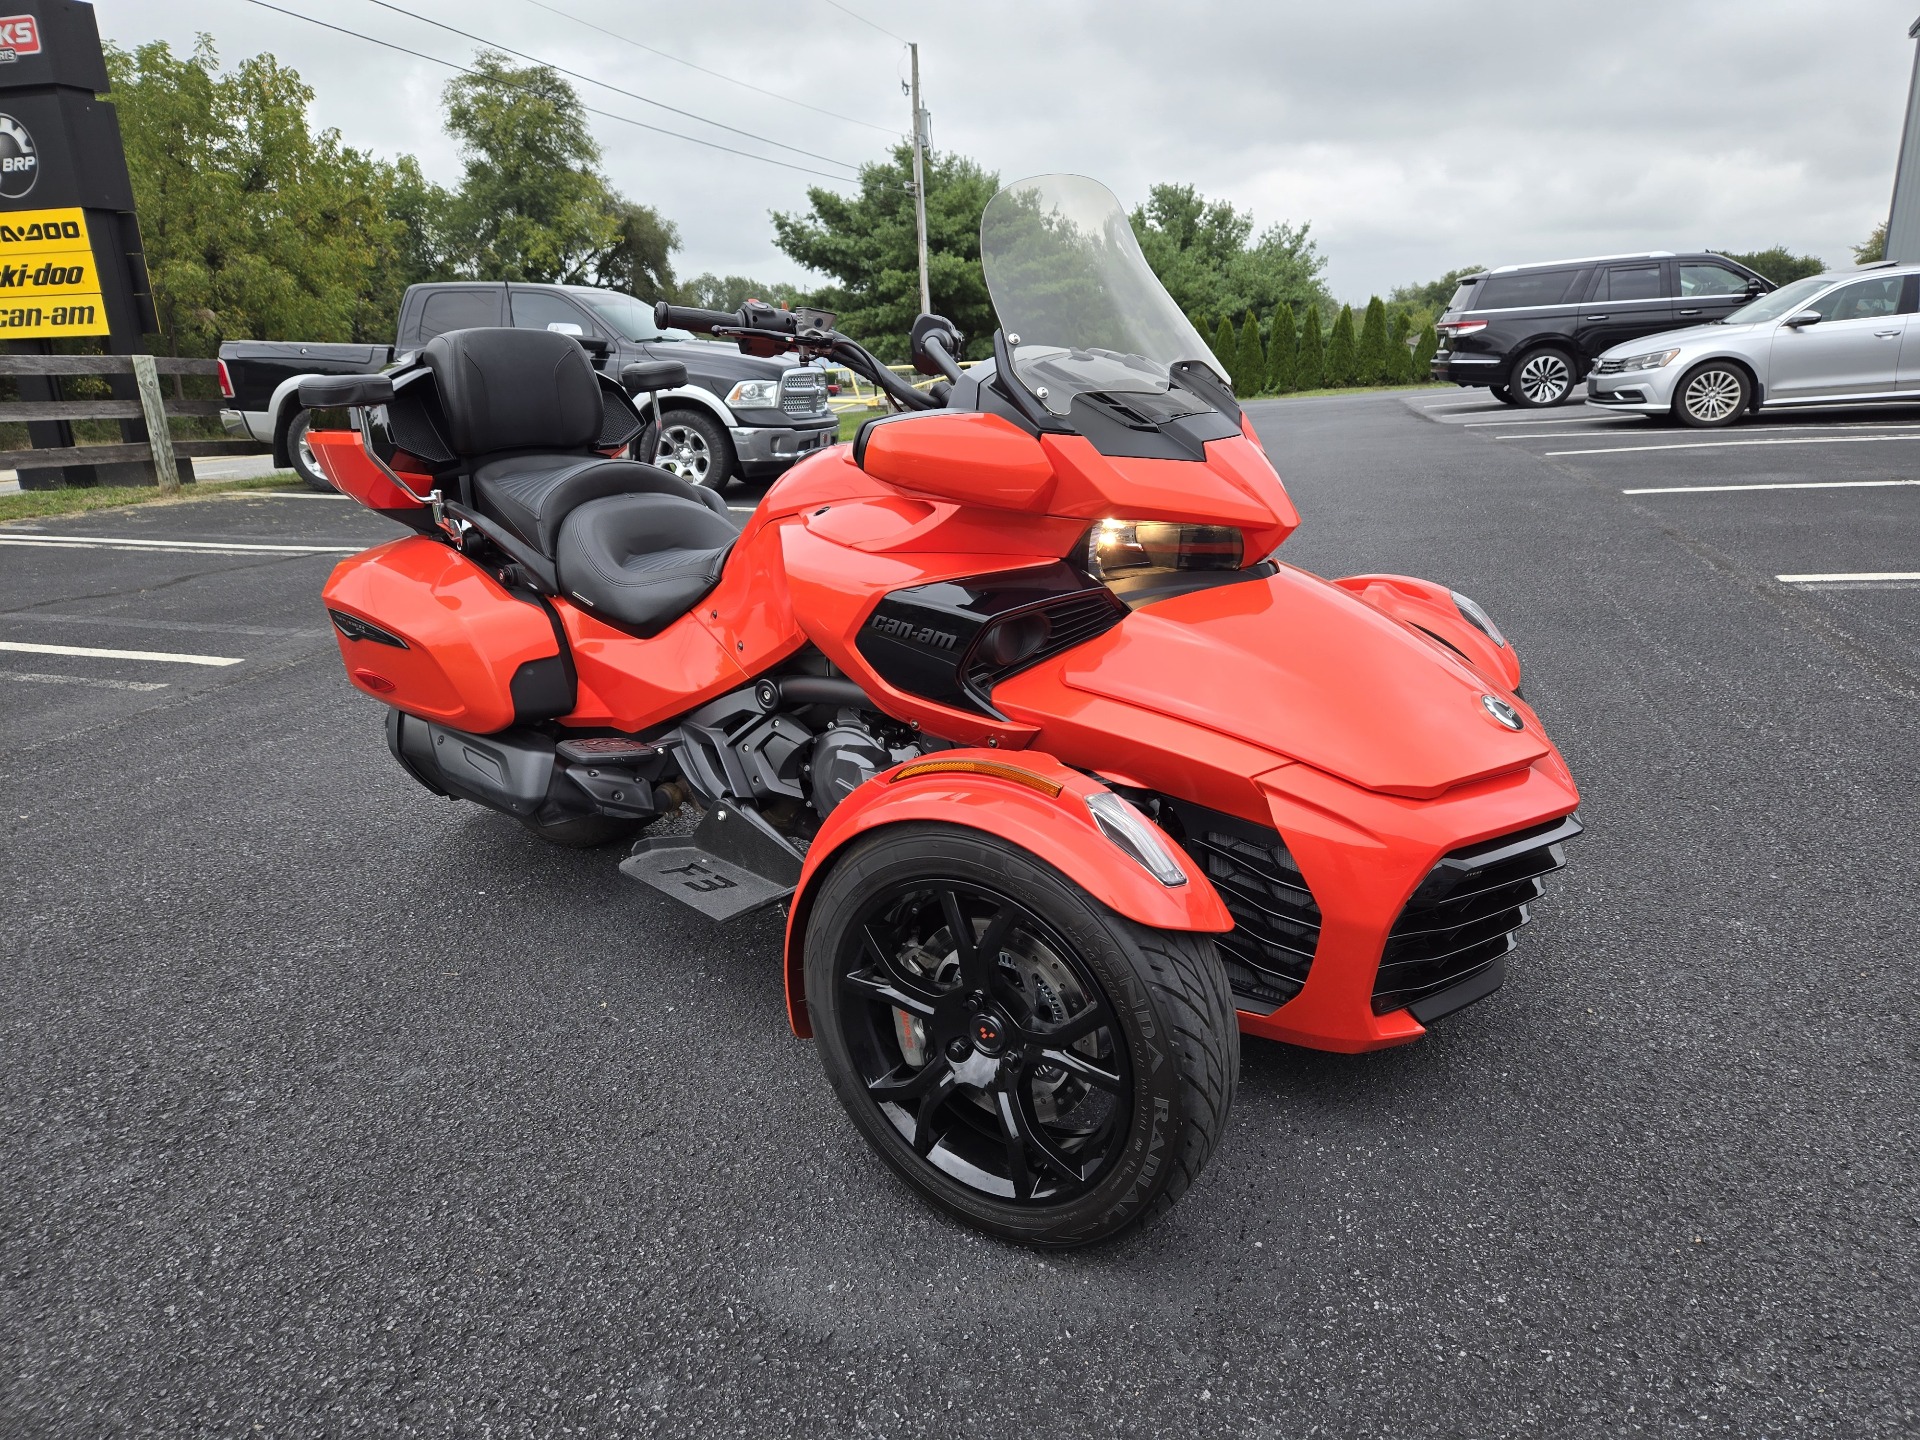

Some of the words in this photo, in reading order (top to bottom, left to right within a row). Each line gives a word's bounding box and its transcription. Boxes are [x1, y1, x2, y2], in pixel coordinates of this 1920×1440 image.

[2, 156, 36, 172] BRP
[0, 263, 84, 287] ki-doo
[871, 614, 957, 649] can-am
[659, 863, 738, 892] F3
[1081, 922, 1165, 1075] KENDA
[1106, 1096, 1170, 1218] RADIAL
